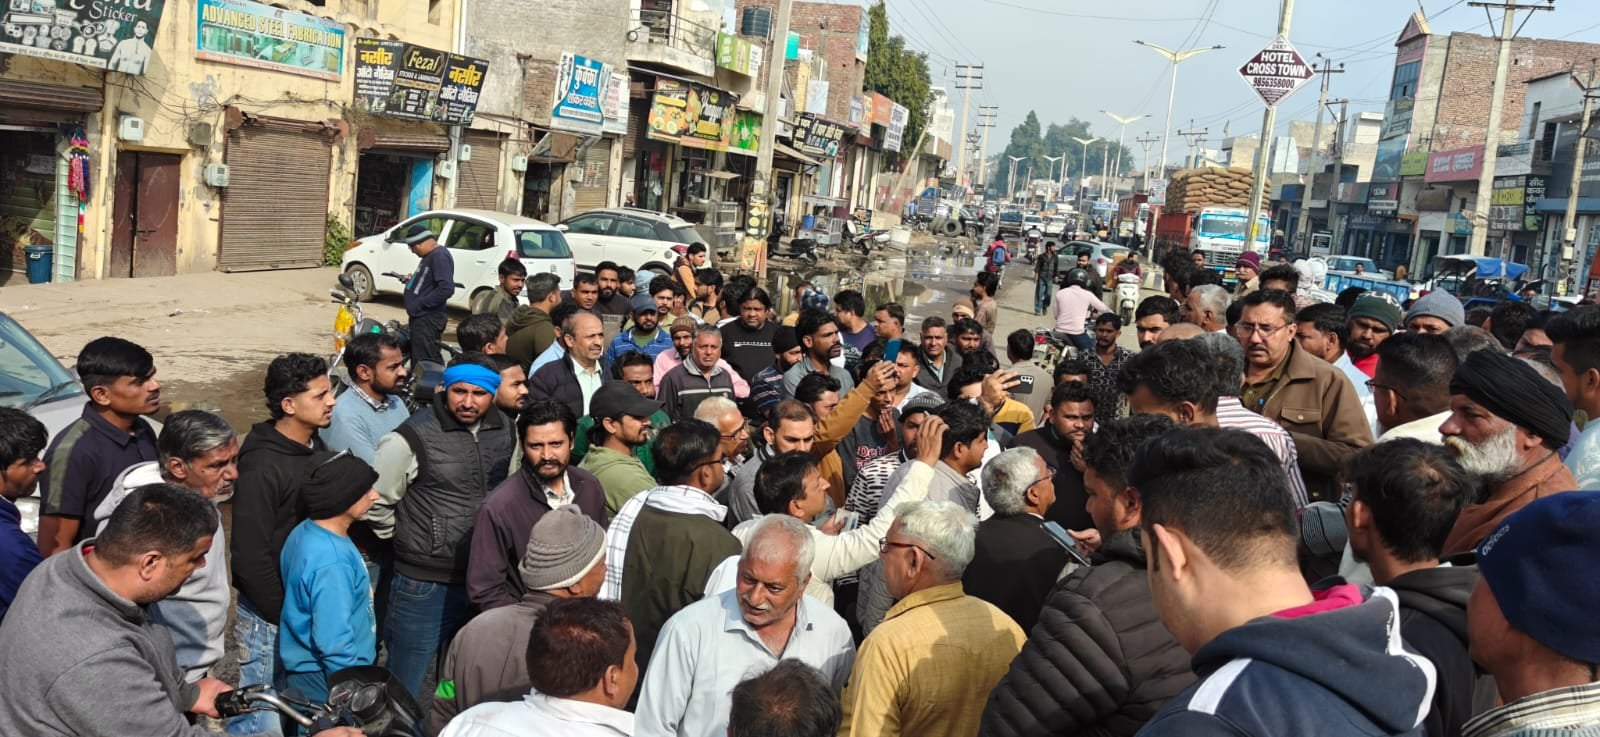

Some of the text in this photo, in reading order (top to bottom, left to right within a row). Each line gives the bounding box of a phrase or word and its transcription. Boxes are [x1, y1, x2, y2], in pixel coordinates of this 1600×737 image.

[88, 1, 138, 22] Sticker
[202, 4, 257, 31] ADVANCED
[259, 16, 285, 38] STEEL
[287, 23, 342, 48] FABRICATION
[360, 48, 393, 65] नसीर
[408, 50, 441, 71] Fezal
[1260, 52, 1295, 63] HOTEL
[448, 64, 483, 87] नसीर
[1246, 62, 1306, 77] CROSS TOWN
[1482, 524, 1510, 556] adidas
